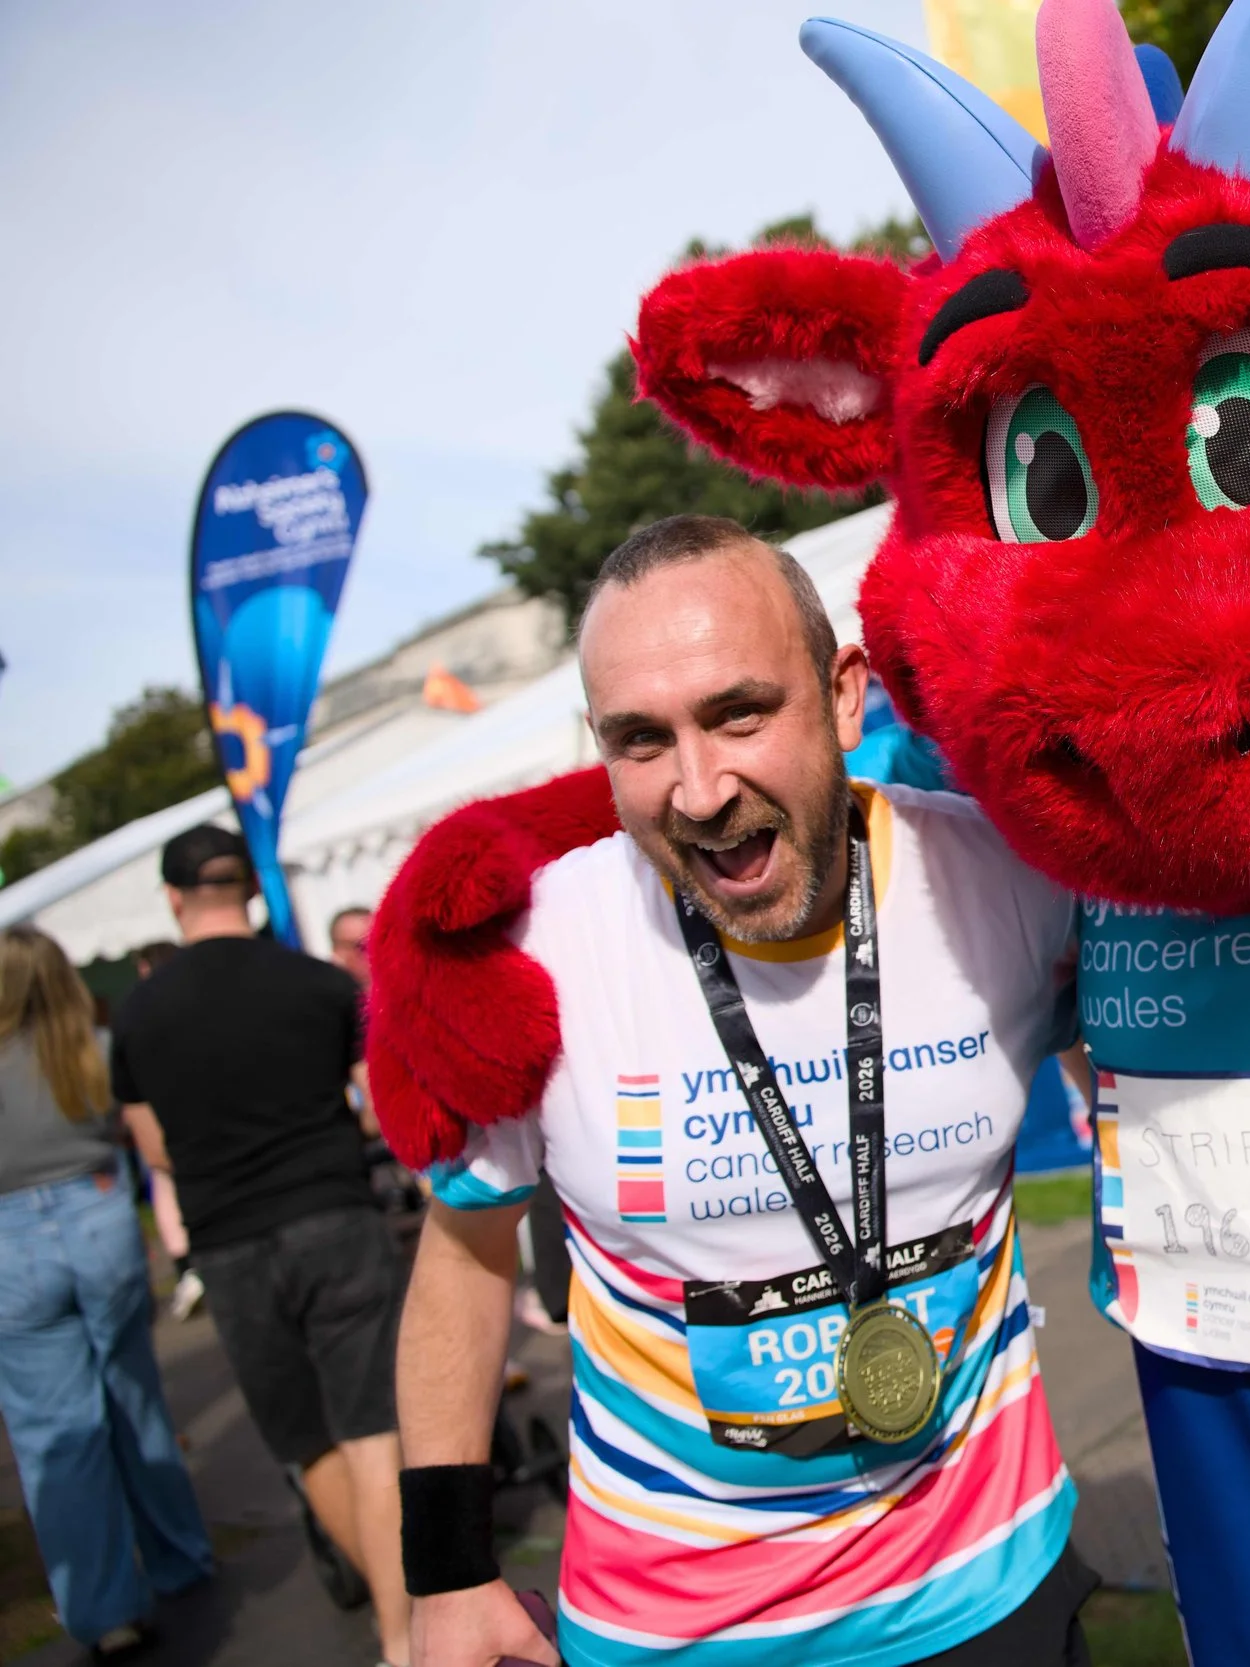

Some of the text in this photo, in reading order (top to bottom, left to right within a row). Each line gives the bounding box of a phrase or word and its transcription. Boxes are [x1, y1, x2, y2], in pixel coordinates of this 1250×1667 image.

[850, 876, 863, 936] CARDIFF
[1082, 936, 1205, 972] cancer
[1082, 987, 1188, 1029] wales
[681, 1031, 989, 1104] ymhwil anser
[684, 1103, 813, 1145] cymu
[686, 1144, 825, 1183] cancr
[856, 1056, 874, 1240] CARDIFF HALF 2026
[760, 1087, 844, 1256] CARDIFF HALF 2026
[690, 1186, 798, 1221] wale
[886, 1243, 925, 1270] ALF
[748, 1286, 936, 1367] ROBT
[775, 1361, 837, 1407] 20
